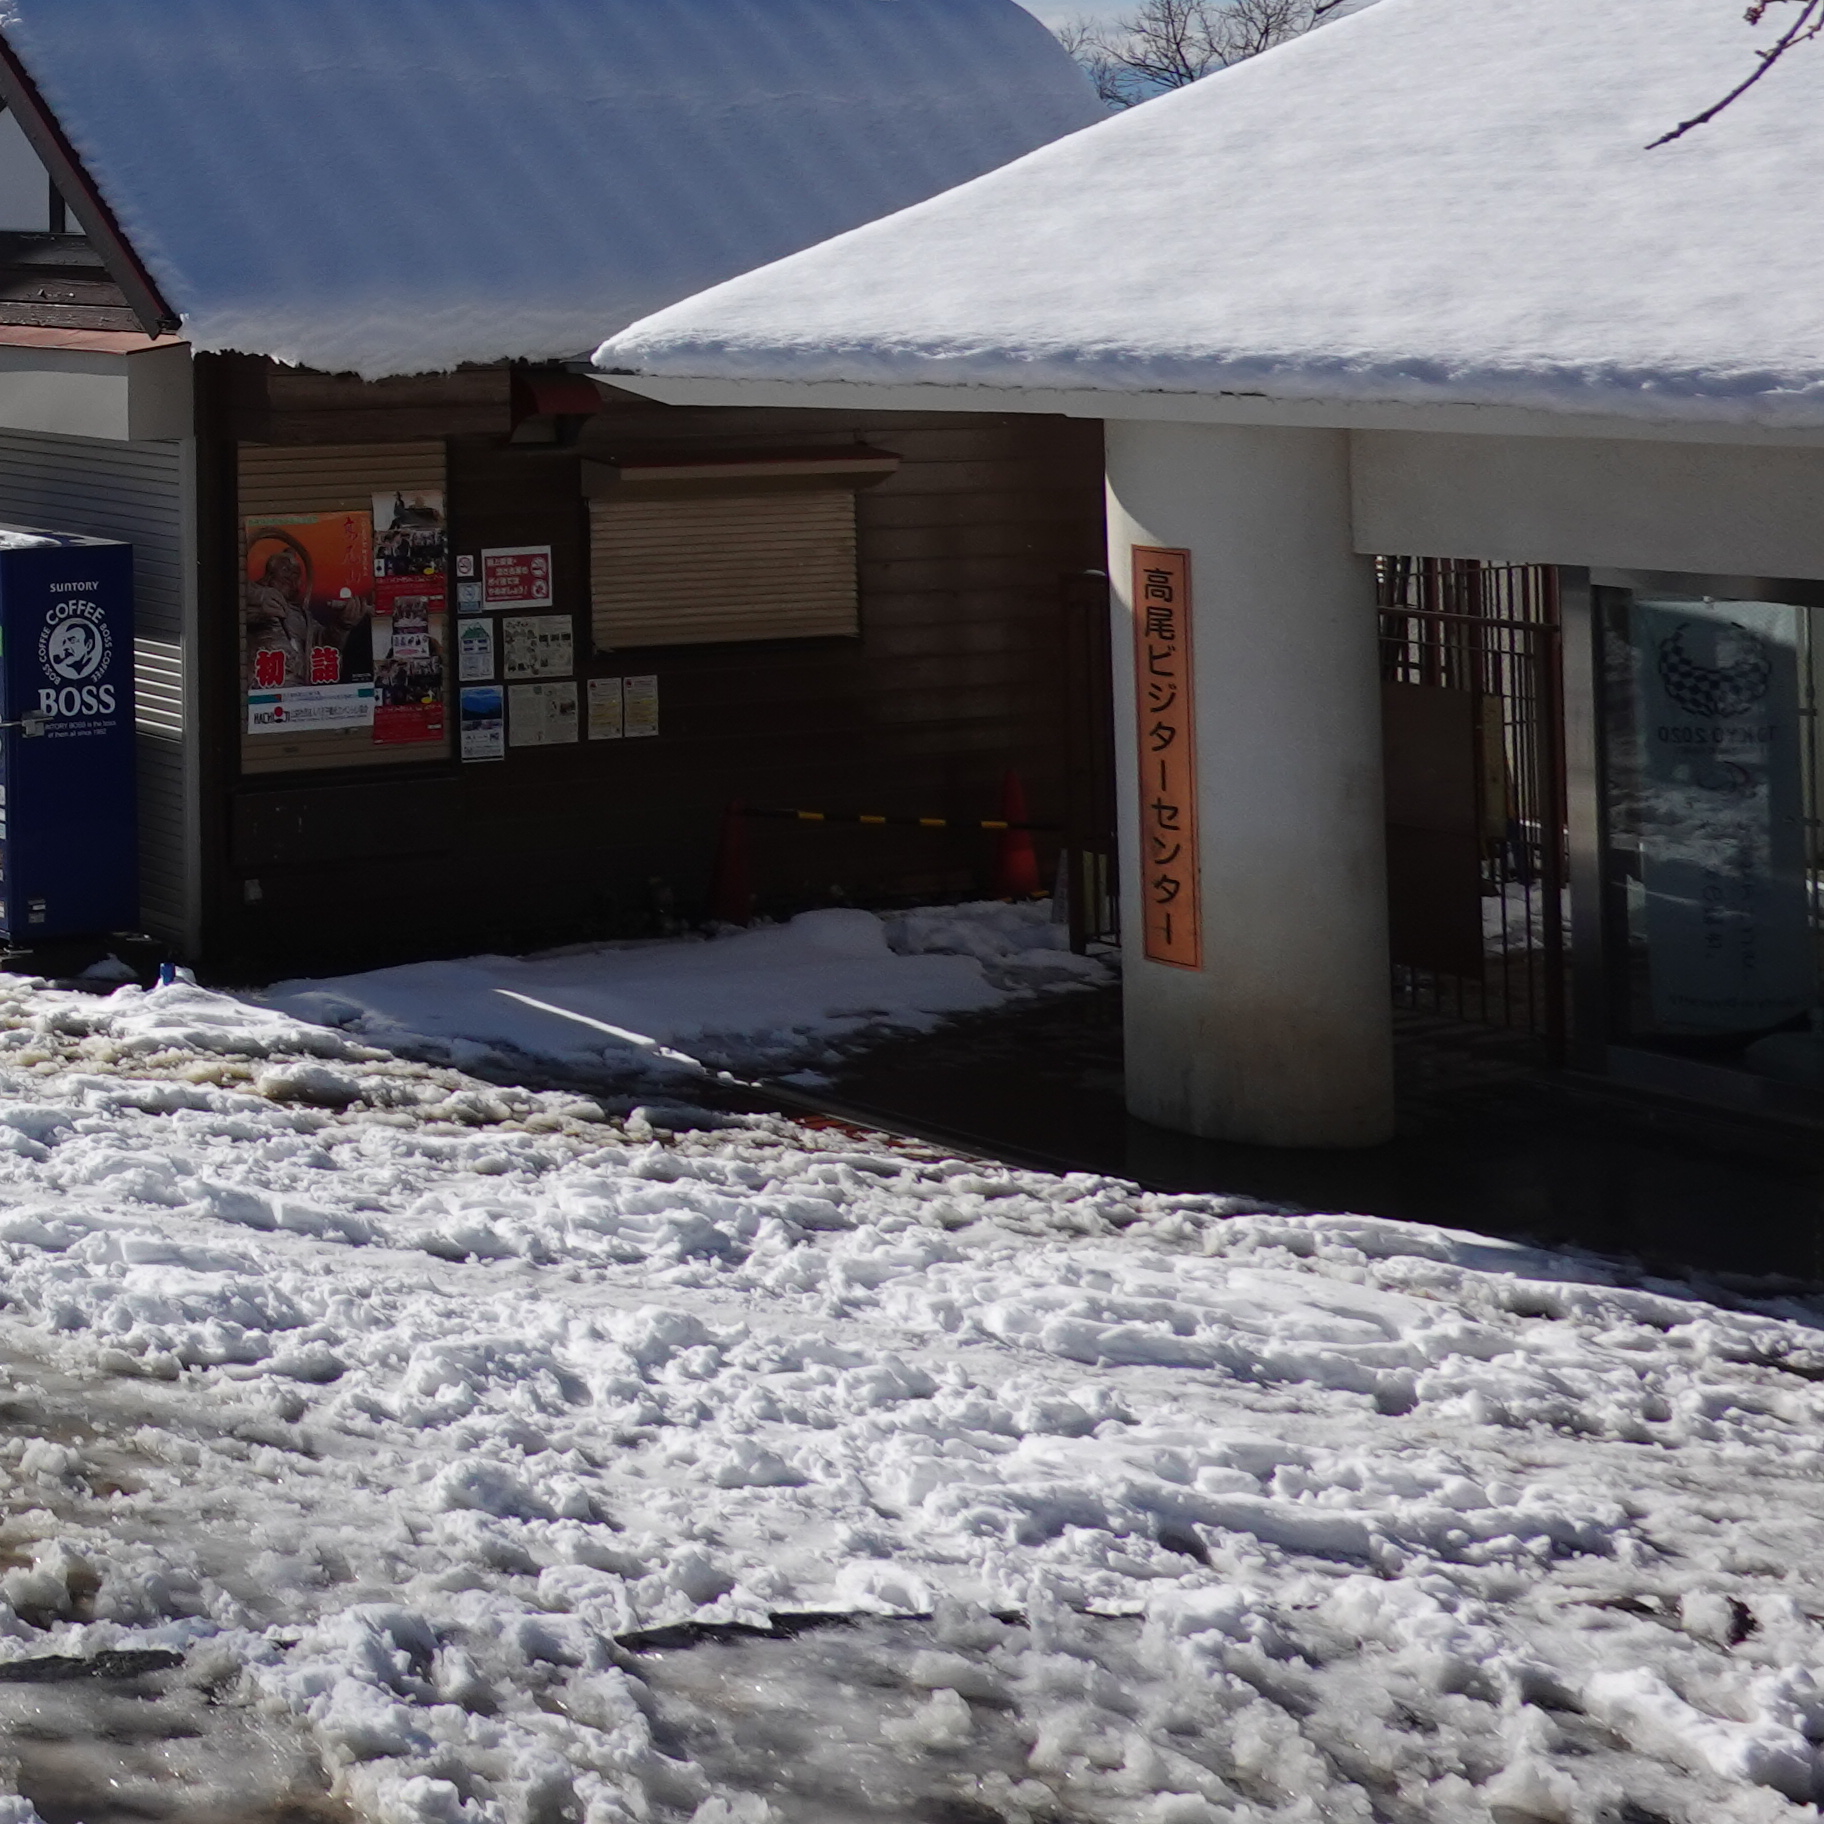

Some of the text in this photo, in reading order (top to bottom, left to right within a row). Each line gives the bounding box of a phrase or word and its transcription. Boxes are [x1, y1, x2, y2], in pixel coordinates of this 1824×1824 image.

[46, 600, 106, 626] COFFEE
[99, 621, 113, 648] BOSS
[38, 684, 116, 717] BOSS
[1143, 567, 1181, 946] 高尾ビジターセンター
